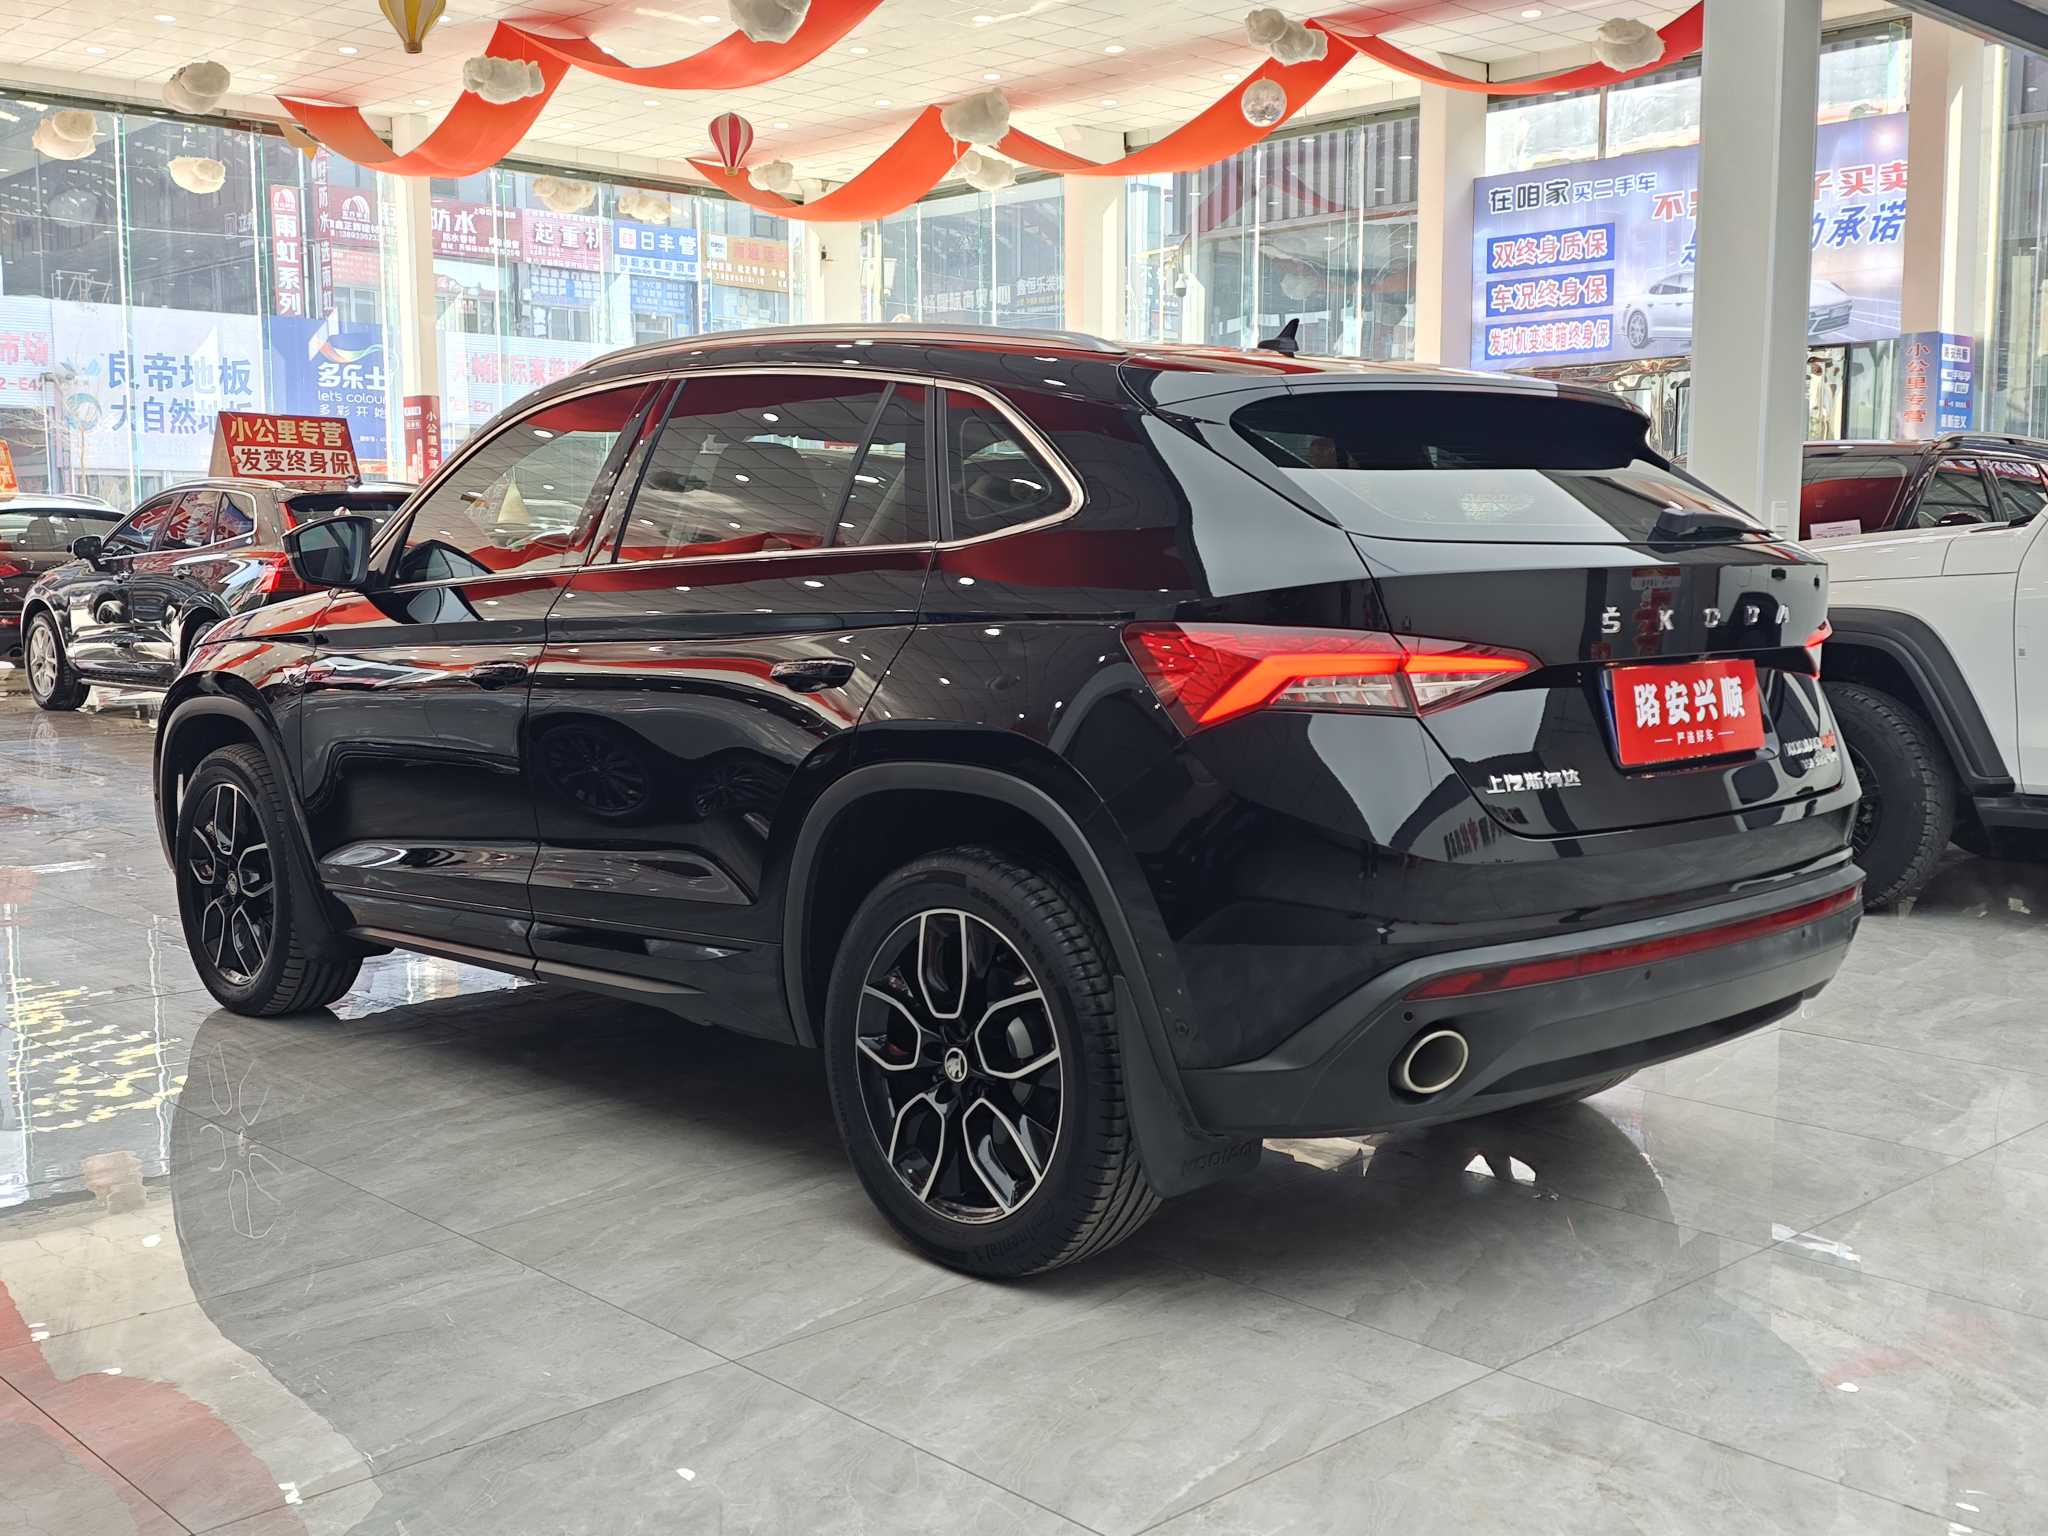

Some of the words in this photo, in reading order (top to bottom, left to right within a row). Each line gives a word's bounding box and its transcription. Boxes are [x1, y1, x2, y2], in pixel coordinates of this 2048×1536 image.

[640, 231, 697, 256] 日丰管
[1492, 228, 1608, 269] 双终身质保
[274, 213, 301, 315] 雨虹系列
[1491, 274, 1607, 312] 车况终身保
[1489, 318, 1610, 355] 发动机变速箱终身保
[317, 361, 386, 391] 多乐士
[1903, 343, 1930, 424] 小公里专营
[230, 416, 344, 448] 小公里专营
[240, 448, 351, 476] 发变终身保
[1633, 675, 1746, 729] 路安兴顺
[1486, 768, 1582, 794] 上汽斯柯达
